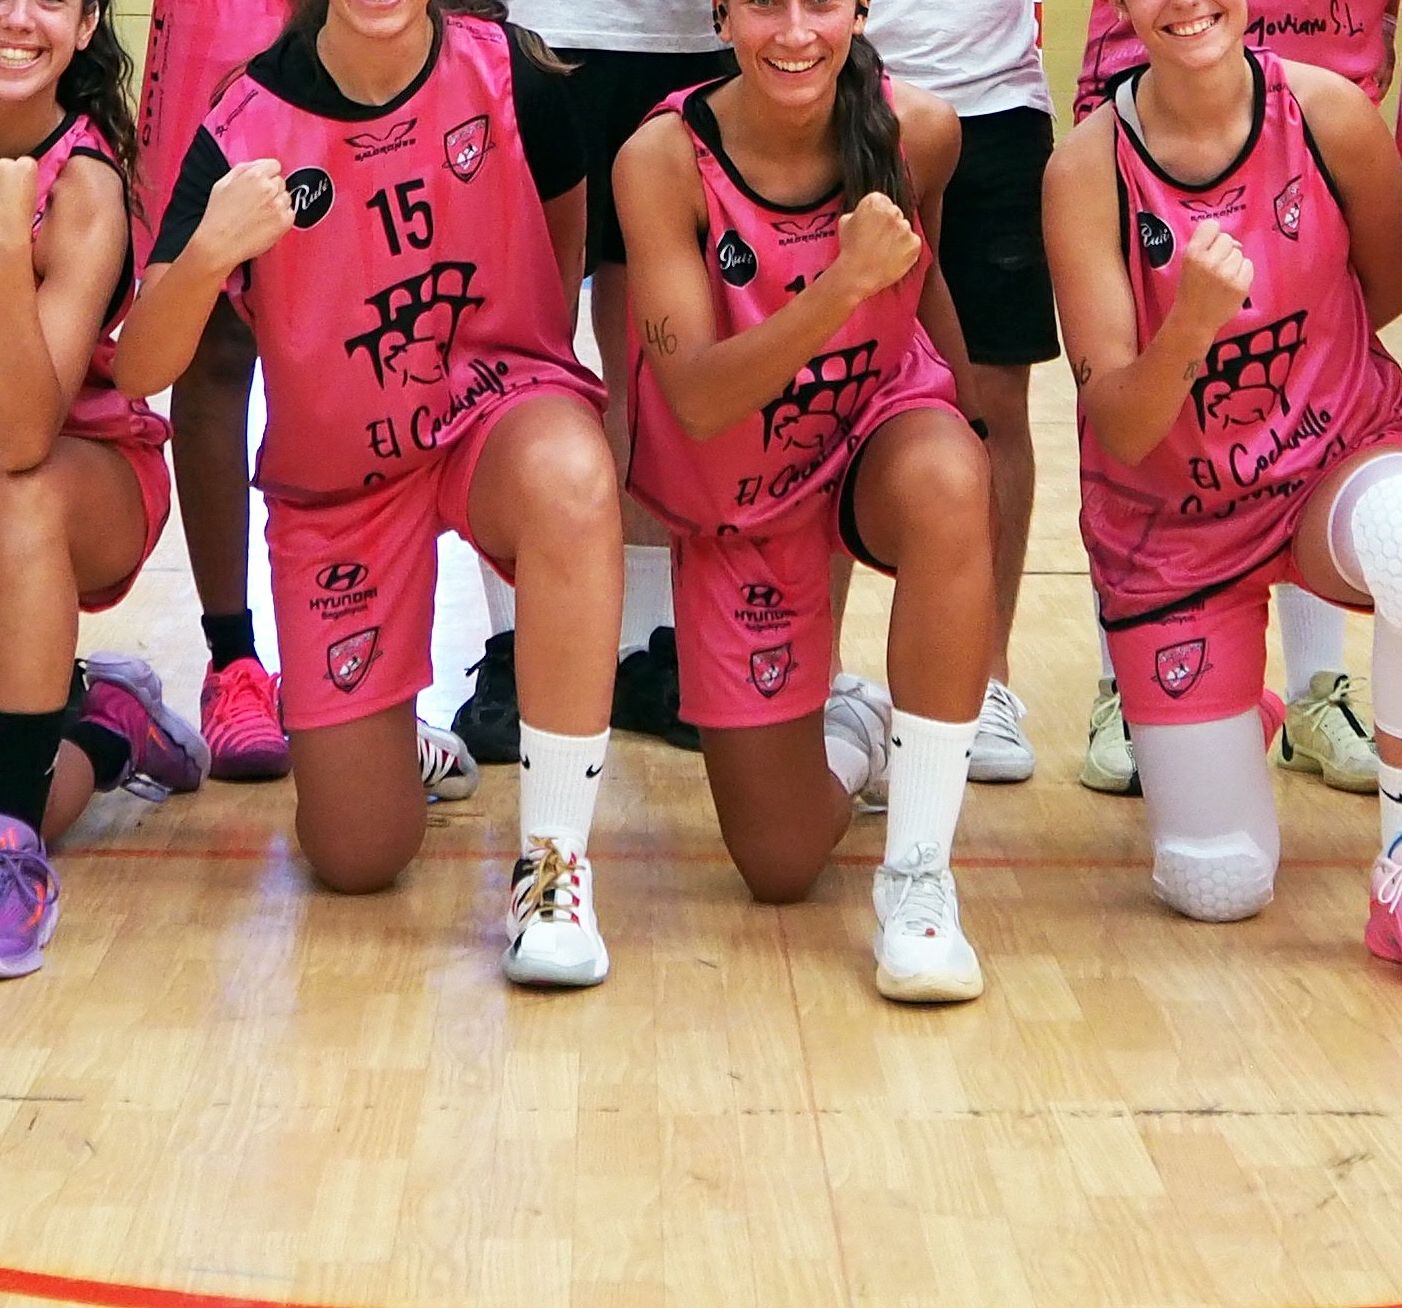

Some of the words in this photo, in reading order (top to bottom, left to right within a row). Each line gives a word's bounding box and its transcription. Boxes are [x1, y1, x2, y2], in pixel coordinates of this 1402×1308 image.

[365, 177, 434, 256] 15
[646, 315, 677, 357] 46
[365, 417, 402, 459] El
[1188, 457, 1221, 491] El
[309, 587, 378, 611] HYUNDAI
